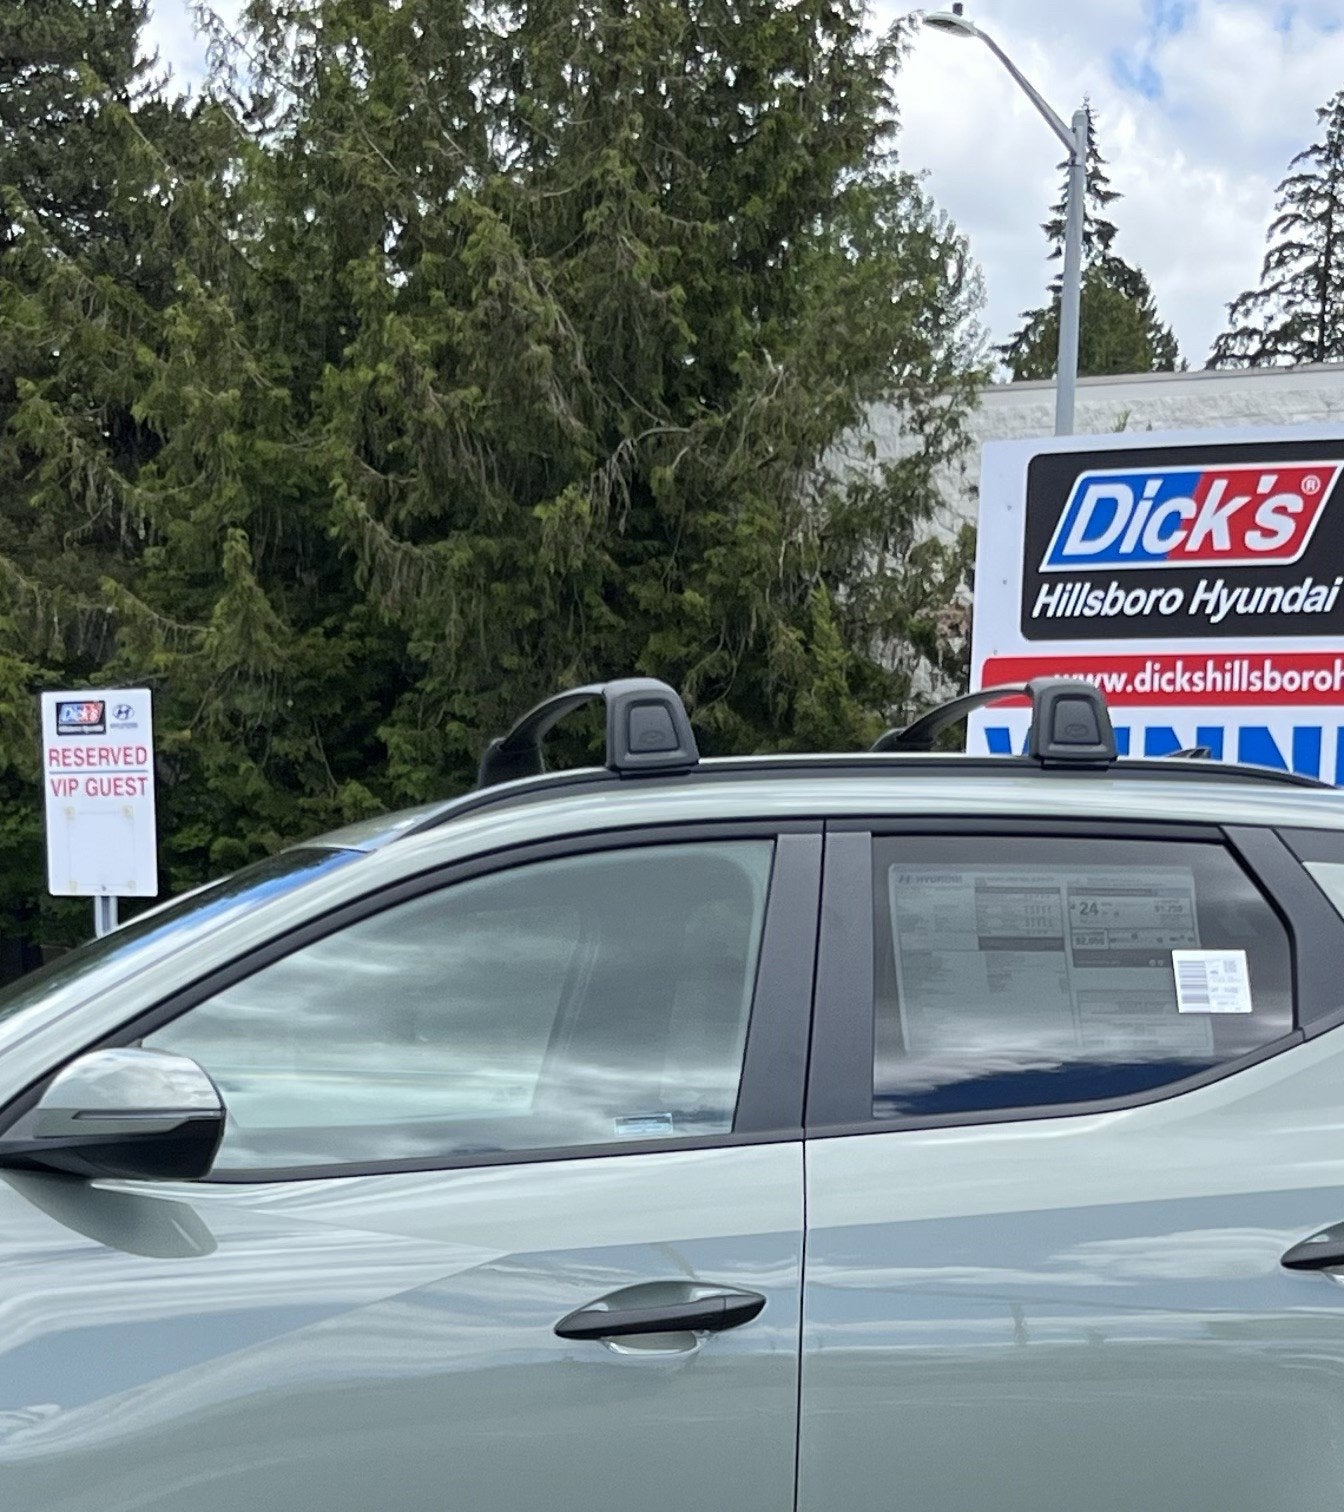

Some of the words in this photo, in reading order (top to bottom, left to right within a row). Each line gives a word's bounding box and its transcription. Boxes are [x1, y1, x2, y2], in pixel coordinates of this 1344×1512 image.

[1031, 575, 1185, 618] Hillsboro
[1188, 576, 1344, 623] Hyundai
[48, 746, 147, 768] RESERVED
[50, 778, 79, 797] VIP
[85, 776, 148, 797] GUEST
[1079, 901, 1099, 916] 24
